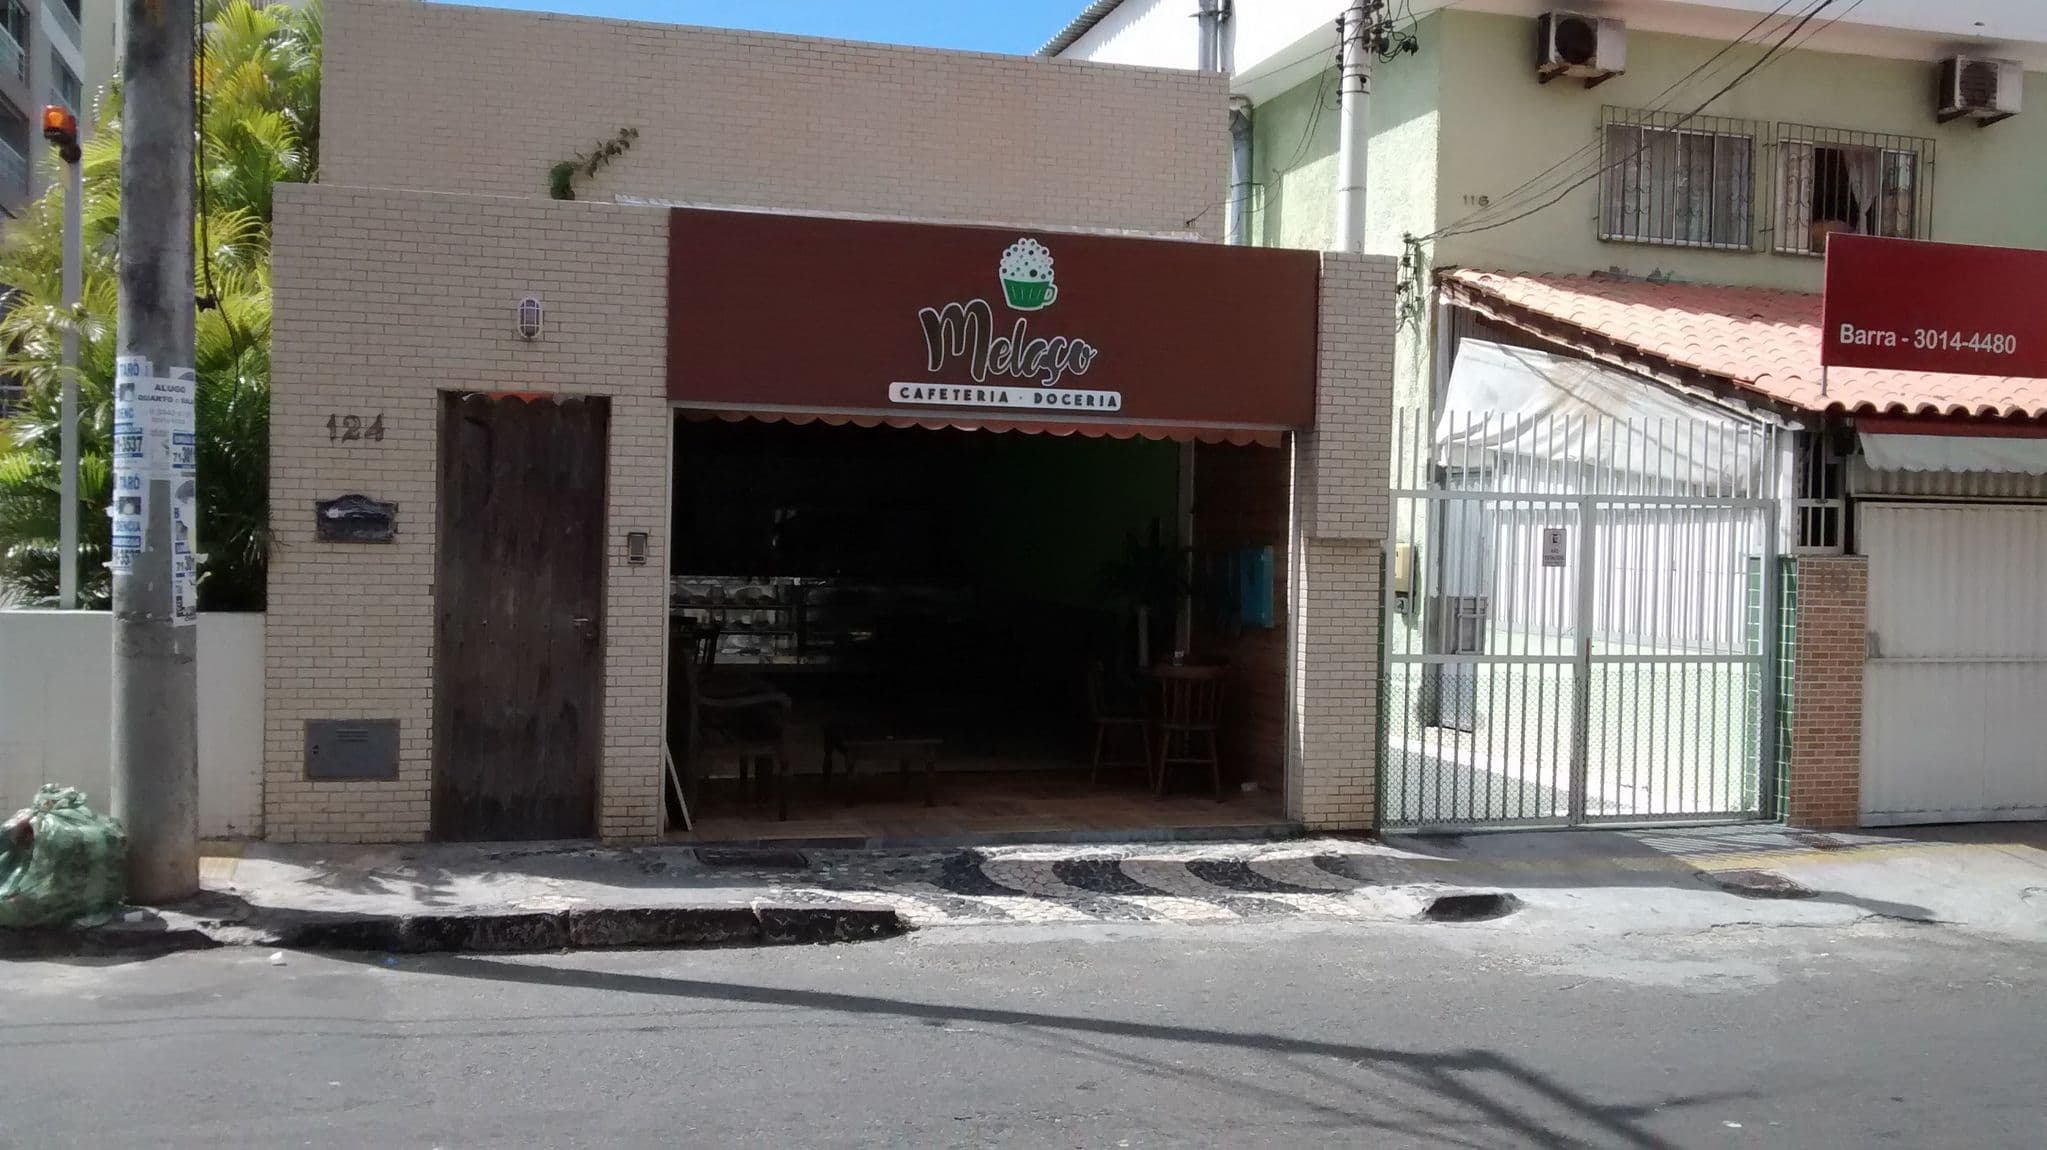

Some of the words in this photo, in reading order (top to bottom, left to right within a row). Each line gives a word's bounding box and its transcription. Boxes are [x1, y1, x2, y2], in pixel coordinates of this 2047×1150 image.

[918, 299, 1098, 387] Melaço
[1839, 323, 1896, 347] Barra
[1913, 328, 2017, 355] 3014-4480
[154, 383, 186, 393] ALUGO
[899, 386, 1009, 404] CAFETERIA
[1033, 391, 1118, 408] DOCERIA
[326, 413, 386, 443] 124
